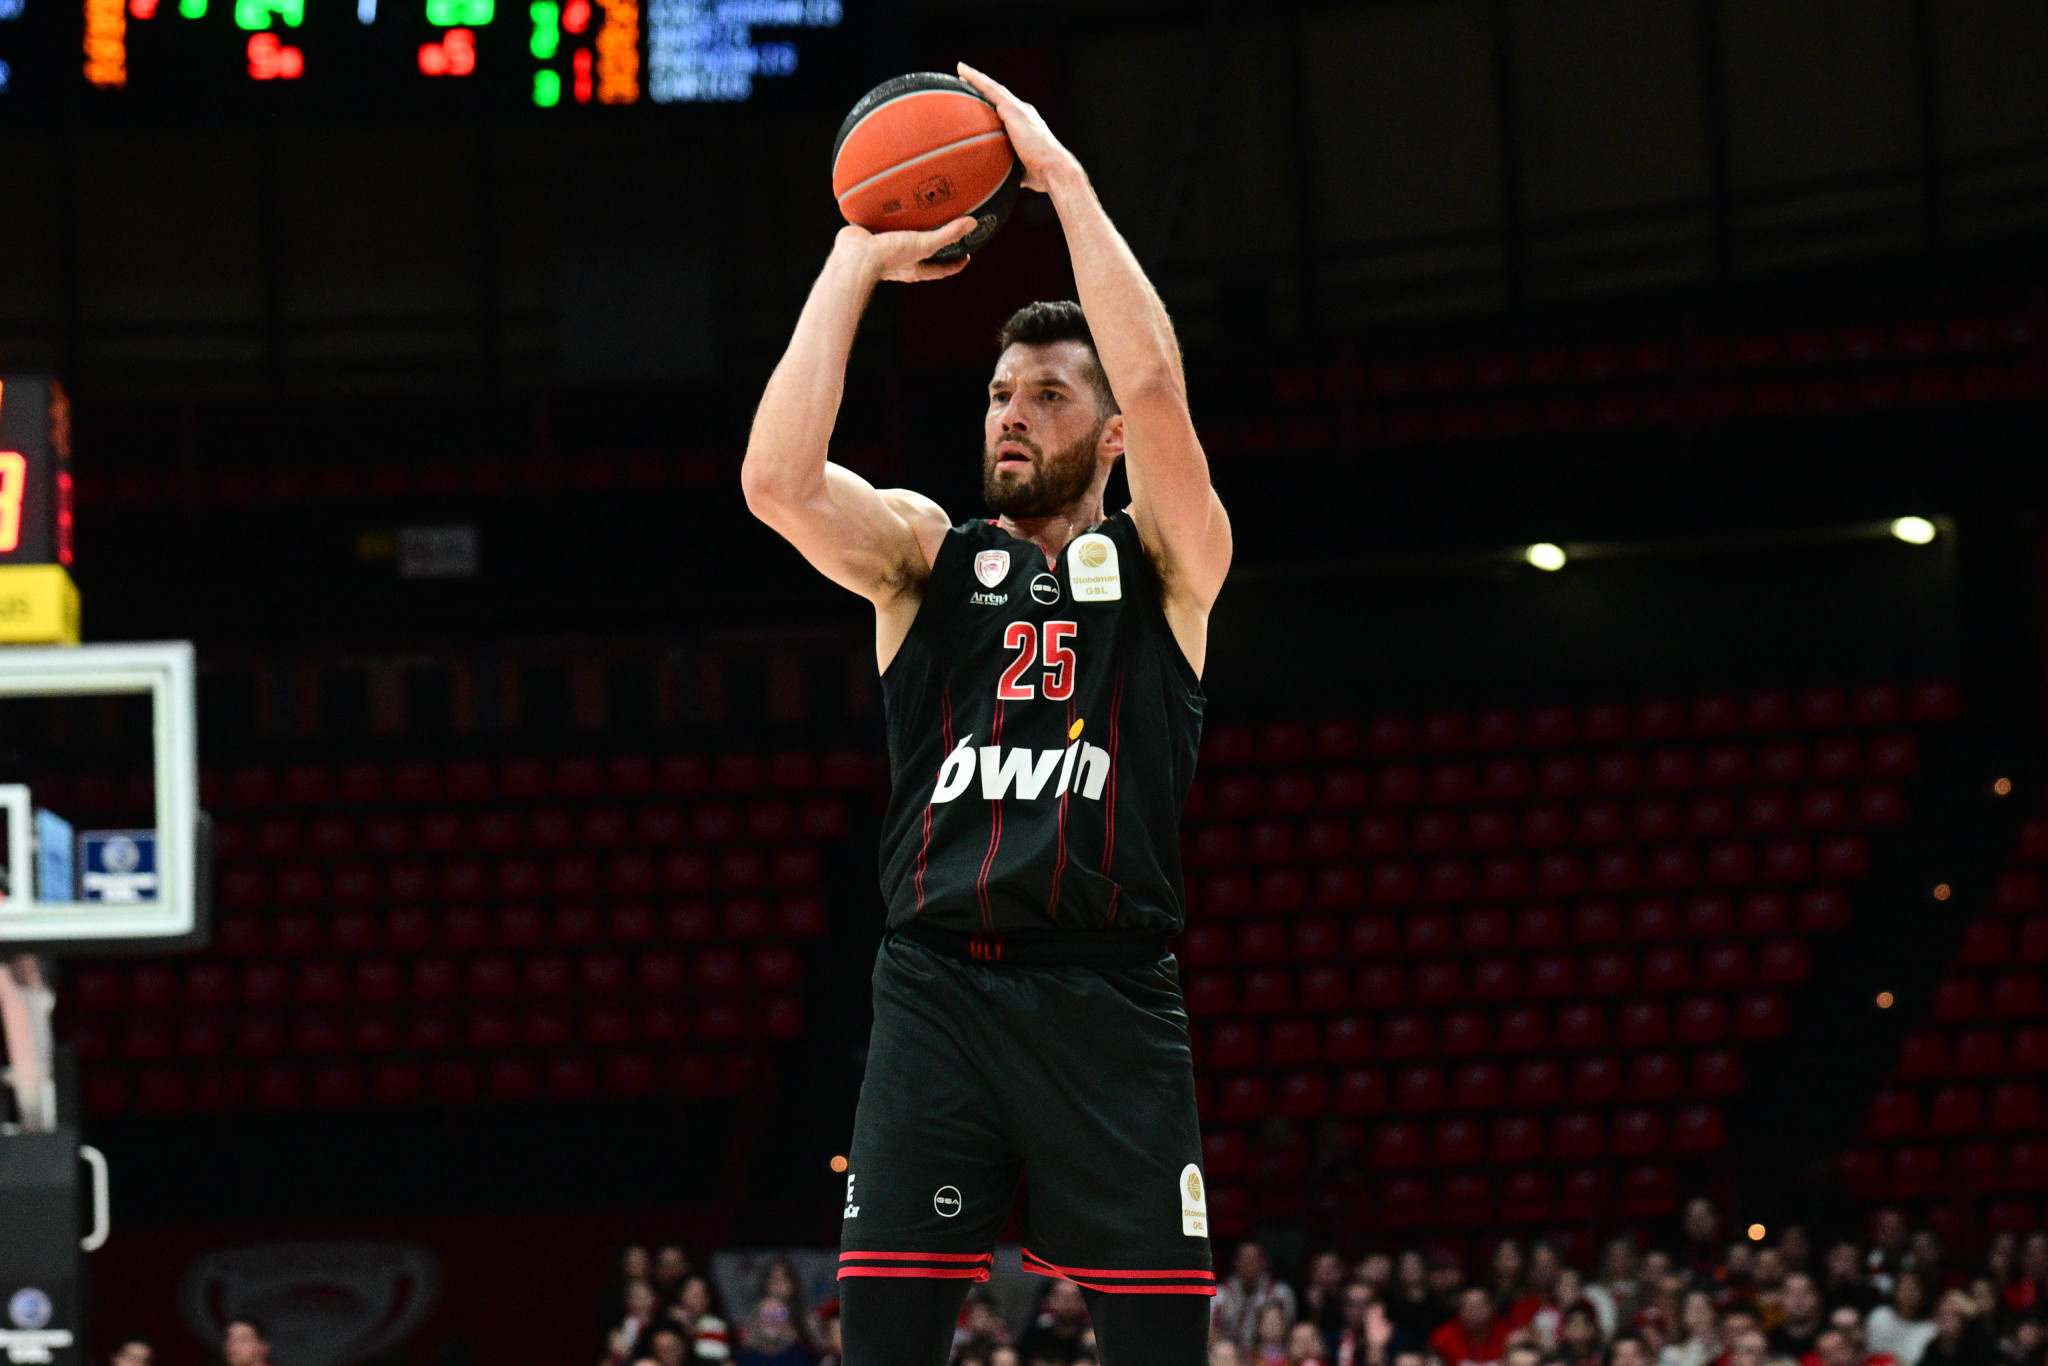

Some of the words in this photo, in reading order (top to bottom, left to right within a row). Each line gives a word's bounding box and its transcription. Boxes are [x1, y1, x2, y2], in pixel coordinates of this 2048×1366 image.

[1085, 586, 1108, 596] GBL
[997, 621, 1077, 701] 25
[930, 718, 1111, 803] bwin
